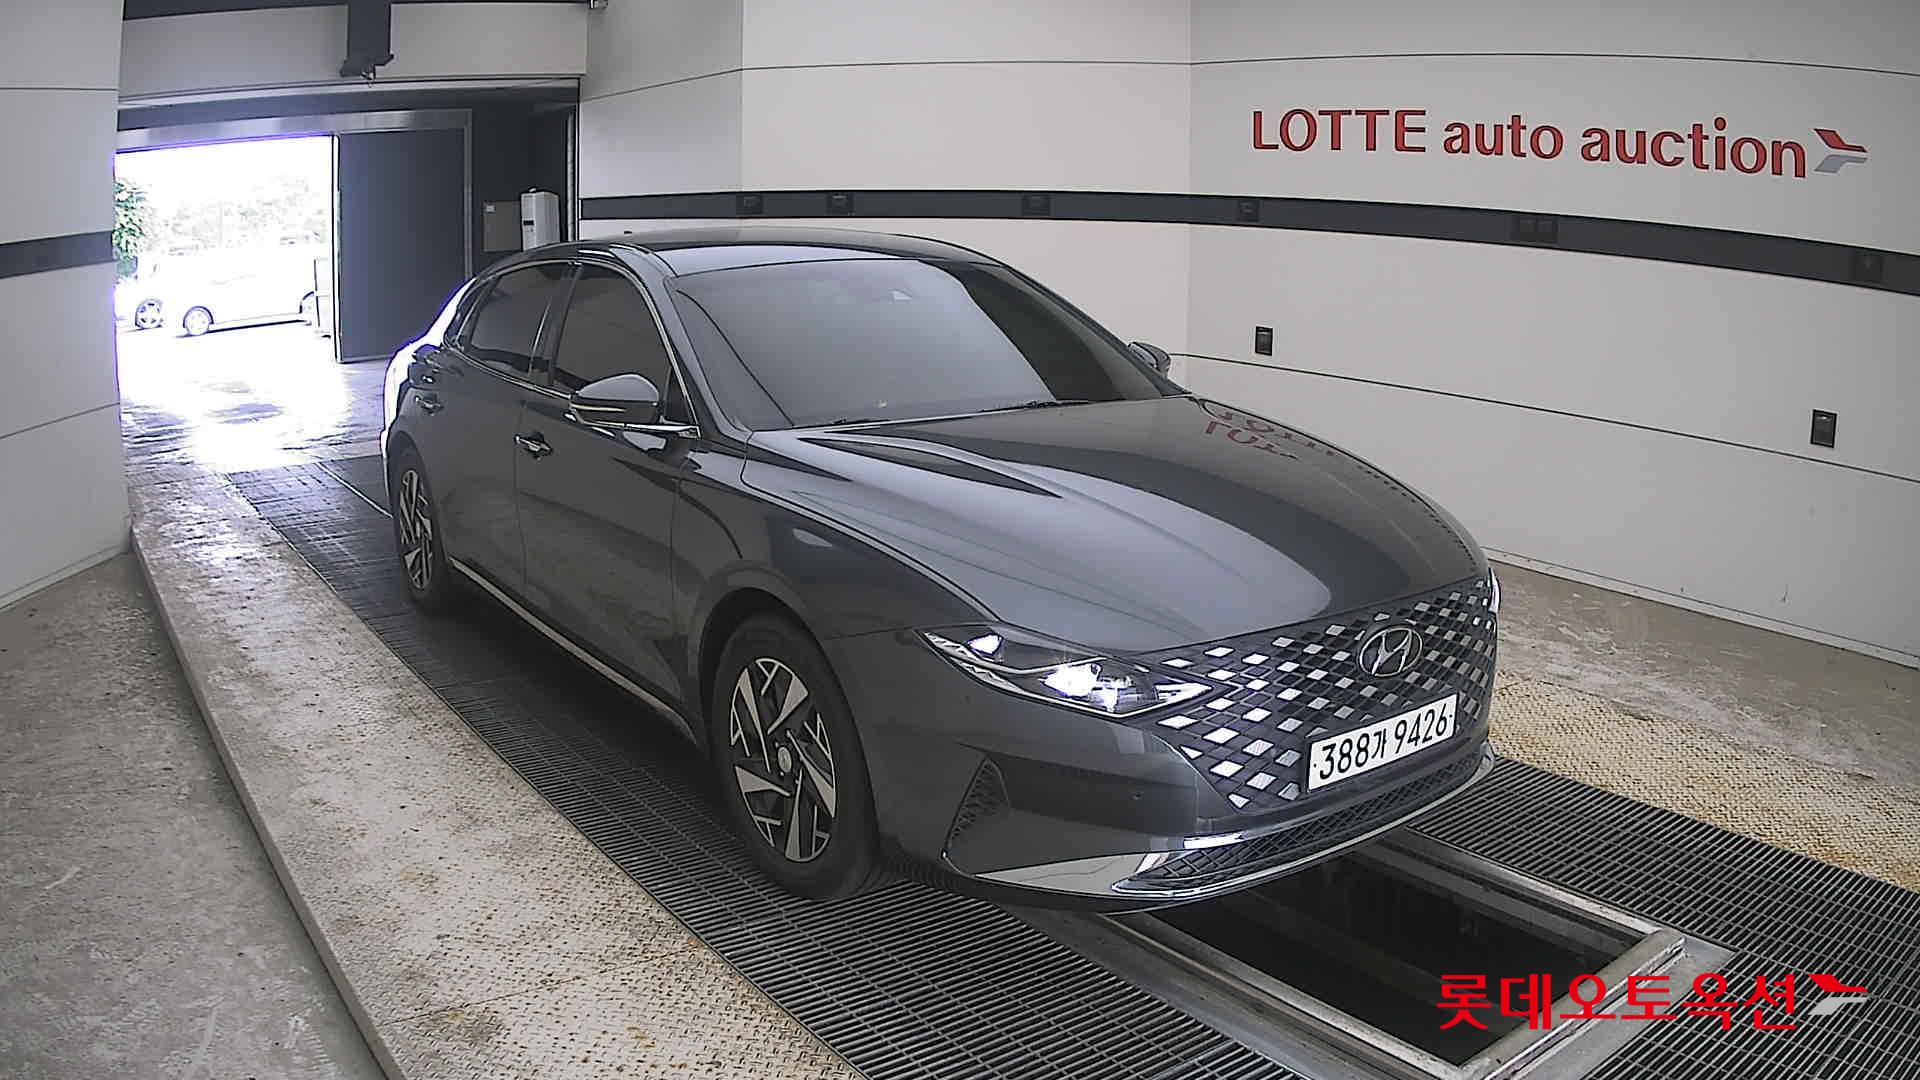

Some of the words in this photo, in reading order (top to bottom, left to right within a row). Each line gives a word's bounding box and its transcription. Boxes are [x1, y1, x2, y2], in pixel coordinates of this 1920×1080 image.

[1252, 109, 1427, 154] LOTTE
[1443, 114, 1564, 160] auto
[1580, 116, 1807, 179] auction
[1319, 728, 1387, 780] 388가
[1394, 703, 1448, 755] 9426
